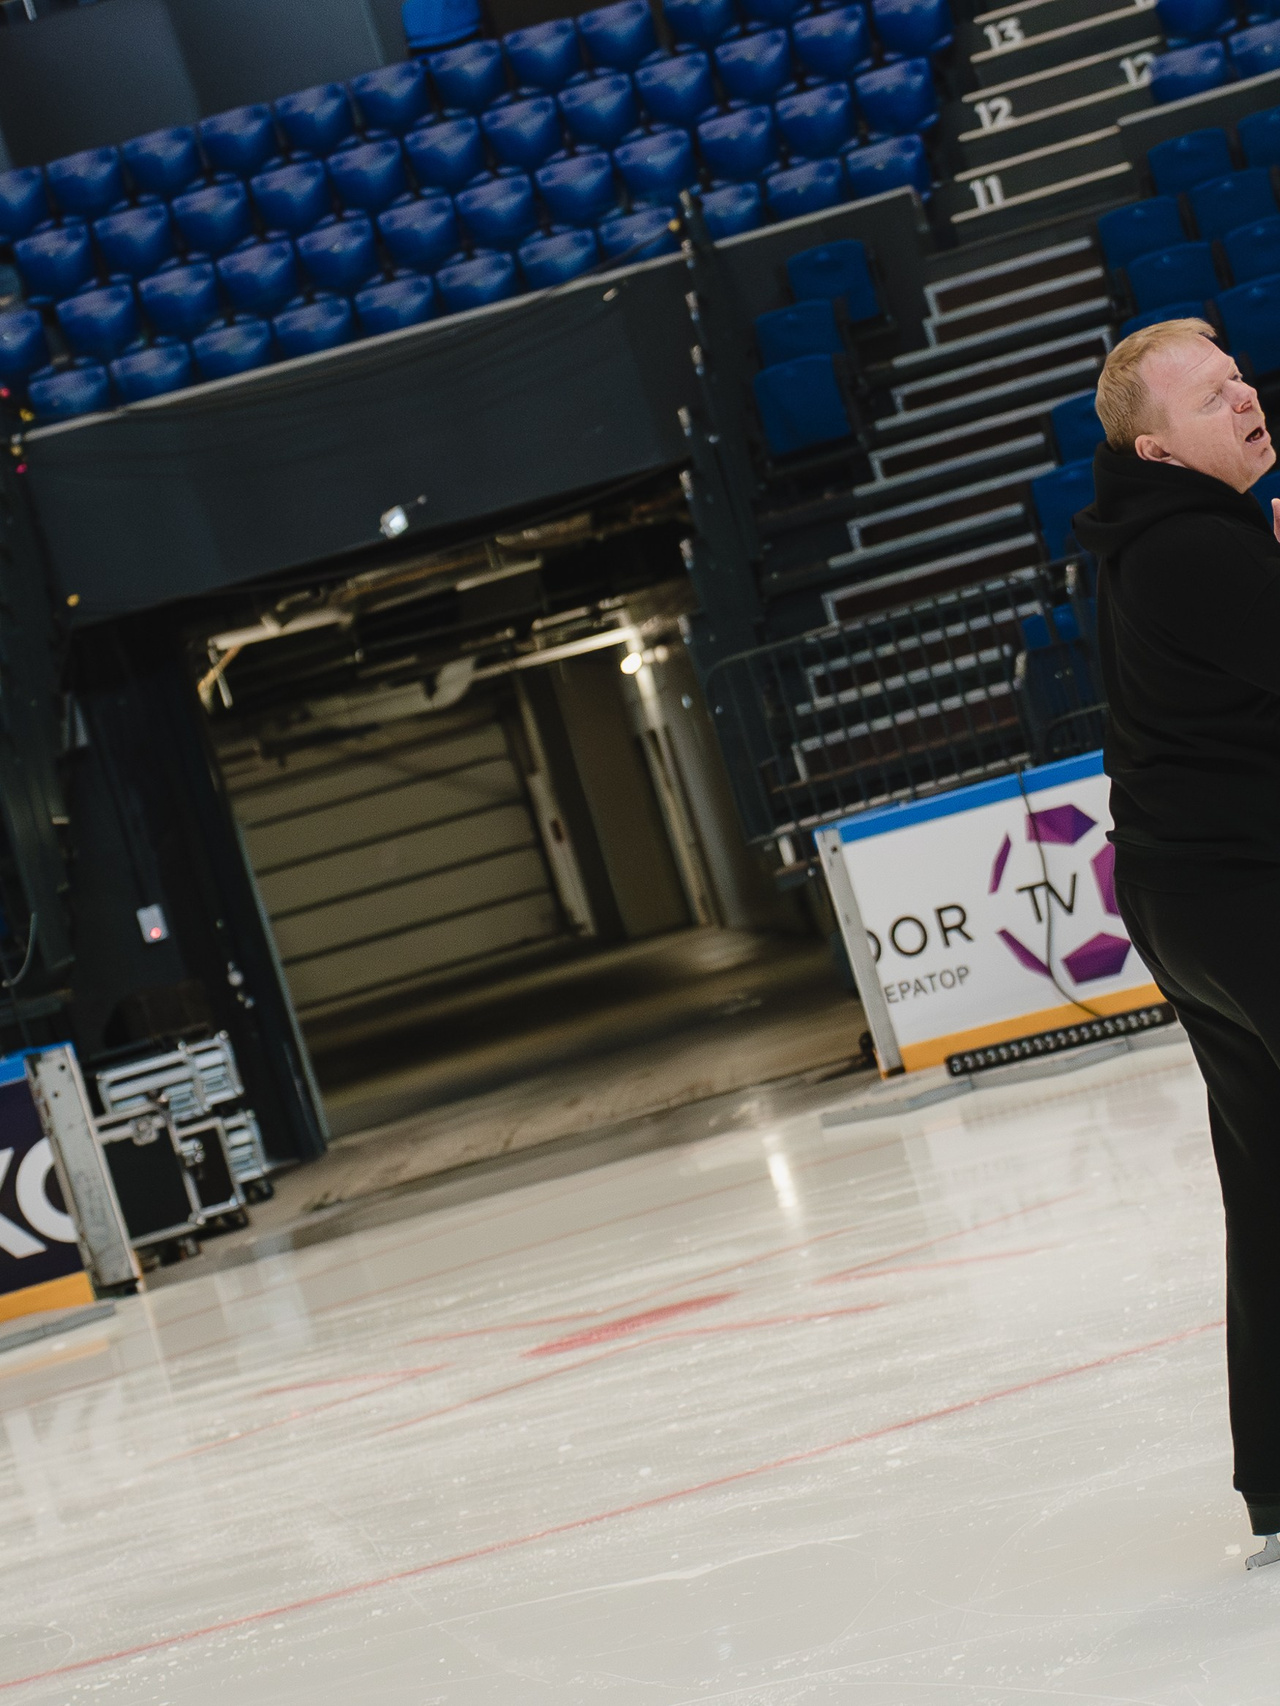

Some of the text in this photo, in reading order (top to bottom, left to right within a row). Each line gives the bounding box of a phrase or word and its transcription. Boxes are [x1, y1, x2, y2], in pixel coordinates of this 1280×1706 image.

[983, 17, 1025, 50] 13
[974, 98, 1014, 131] 12
[969, 175, 1003, 210] 11
[1015, 873, 1077, 923] TV
[883, 966, 969, 1004] ЕРАТОР
